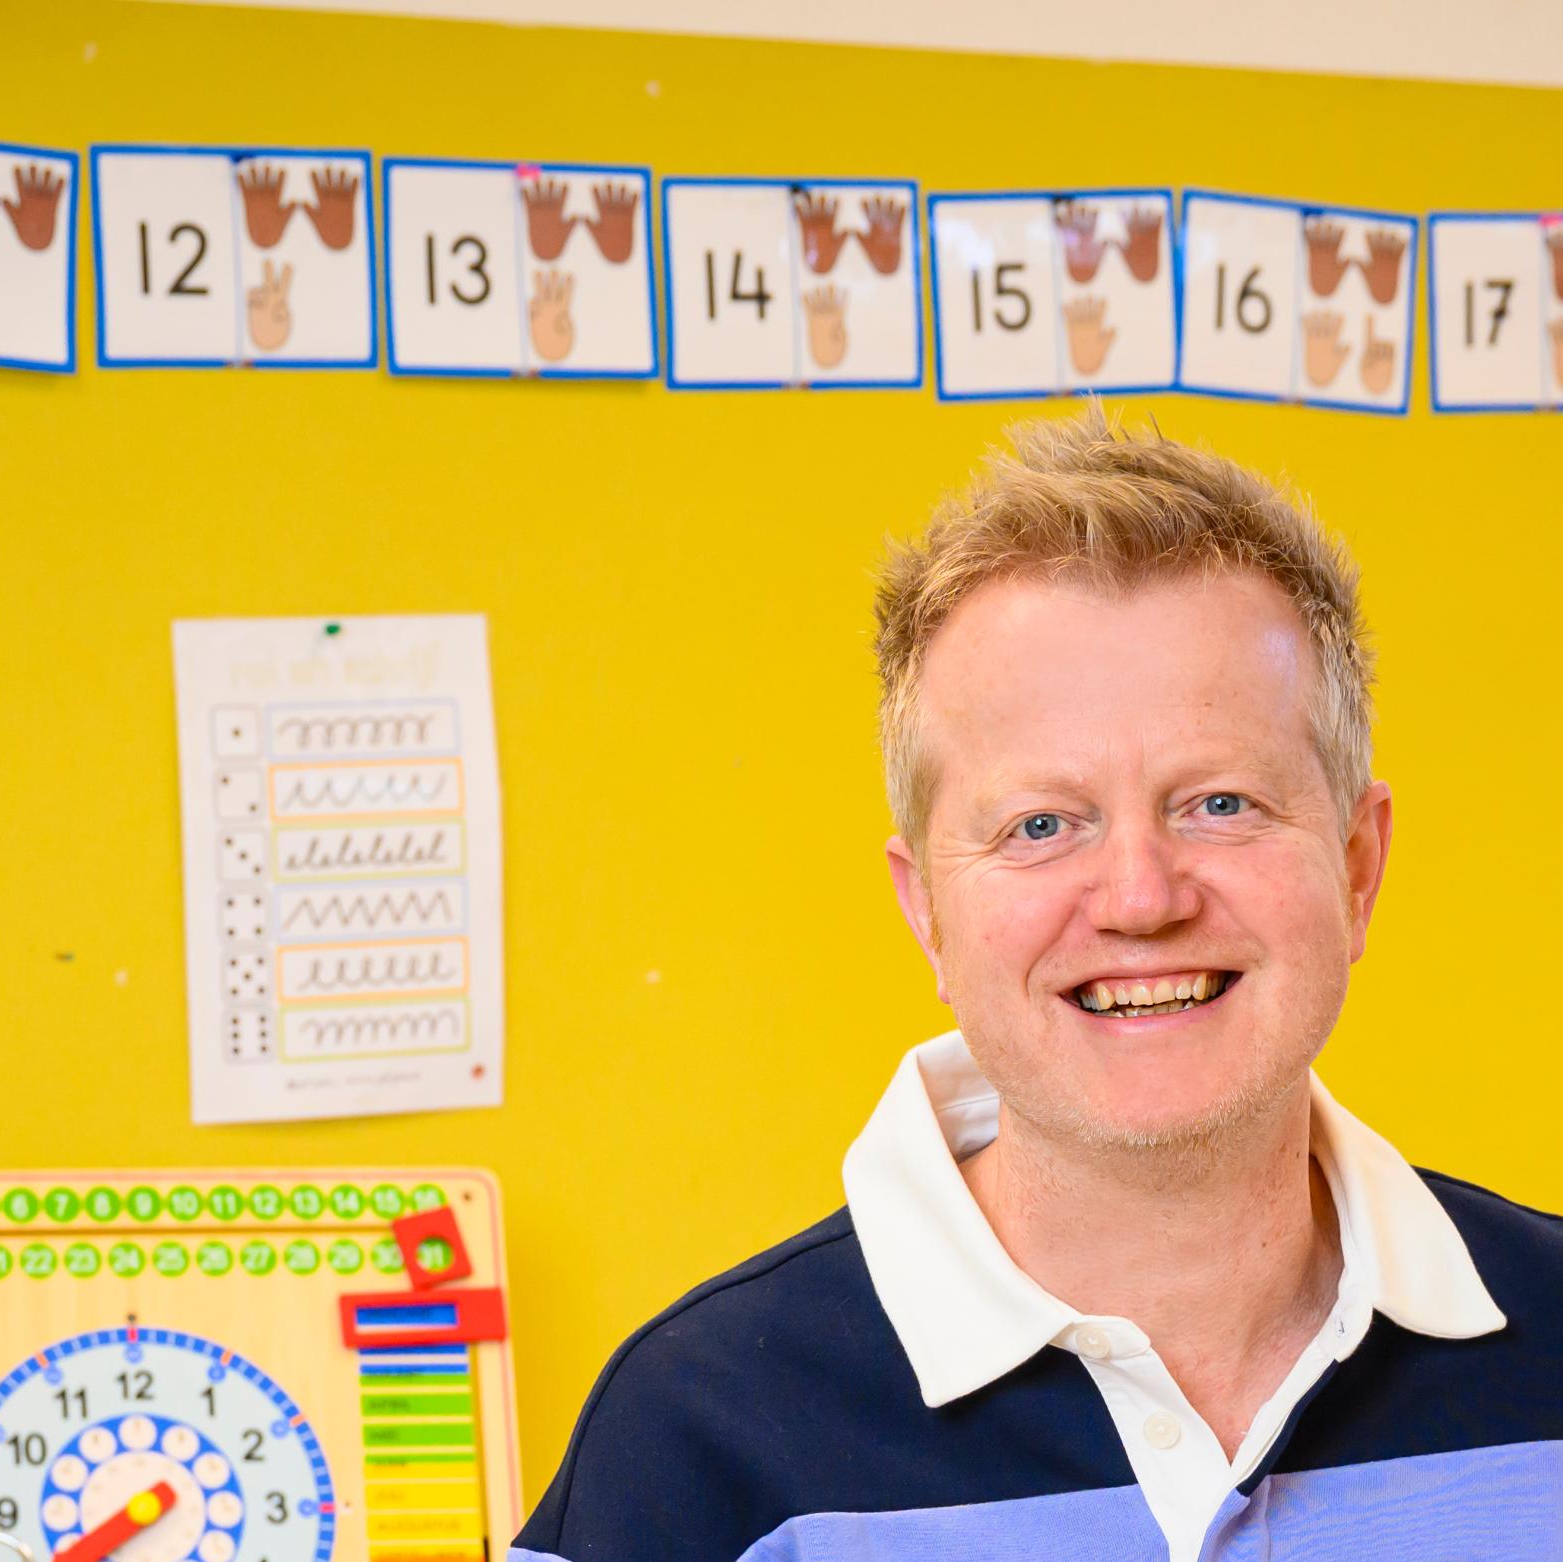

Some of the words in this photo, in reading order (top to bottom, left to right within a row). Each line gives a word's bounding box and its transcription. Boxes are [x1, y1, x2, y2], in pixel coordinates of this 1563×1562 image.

[139, 222, 209, 296] 12
[426, 235, 491, 306] 13
[705, 251, 772, 321] 14
[971, 262, 1032, 332] 15
[1215, 264, 1272, 335] 16
[1464, 279, 1514, 346] 17
[12, 1196, 28, 1218] 6
[55, 1195, 69, 1216] 7
[95, 1195, 111, 1216] 8
[138, 1194, 152, 1214] 9
[174, 1193, 198, 1214] 10
[214, 1193, 235, 1213] 11
[254, 1192, 279, 1212] 12
[295, 1192, 319, 1212] 13
[335, 1191, 359, 1211] 14
[376, 1191, 401, 1211] 15
[26, 1251, 52, 1272] 22
[70, 1250, 95, 1272] 23
[115, 1250, 139, 1270] 24
[159, 1249, 184, 1270] 25
[203, 1248, 227, 1269] 26
[246, 1247, 270, 1268] 27
[290, 1247, 315, 1267] 28
[333, 1246, 358, 1267] 29
[117, 1371, 153, 1400] 12
[202, 1386, 215, 1417] 1
[55, 1388, 88, 1419] 11
[7, 1433, 47, 1466] 10
[242, 1429, 263, 1462] 2
[266, 1491, 289, 1525] 3
